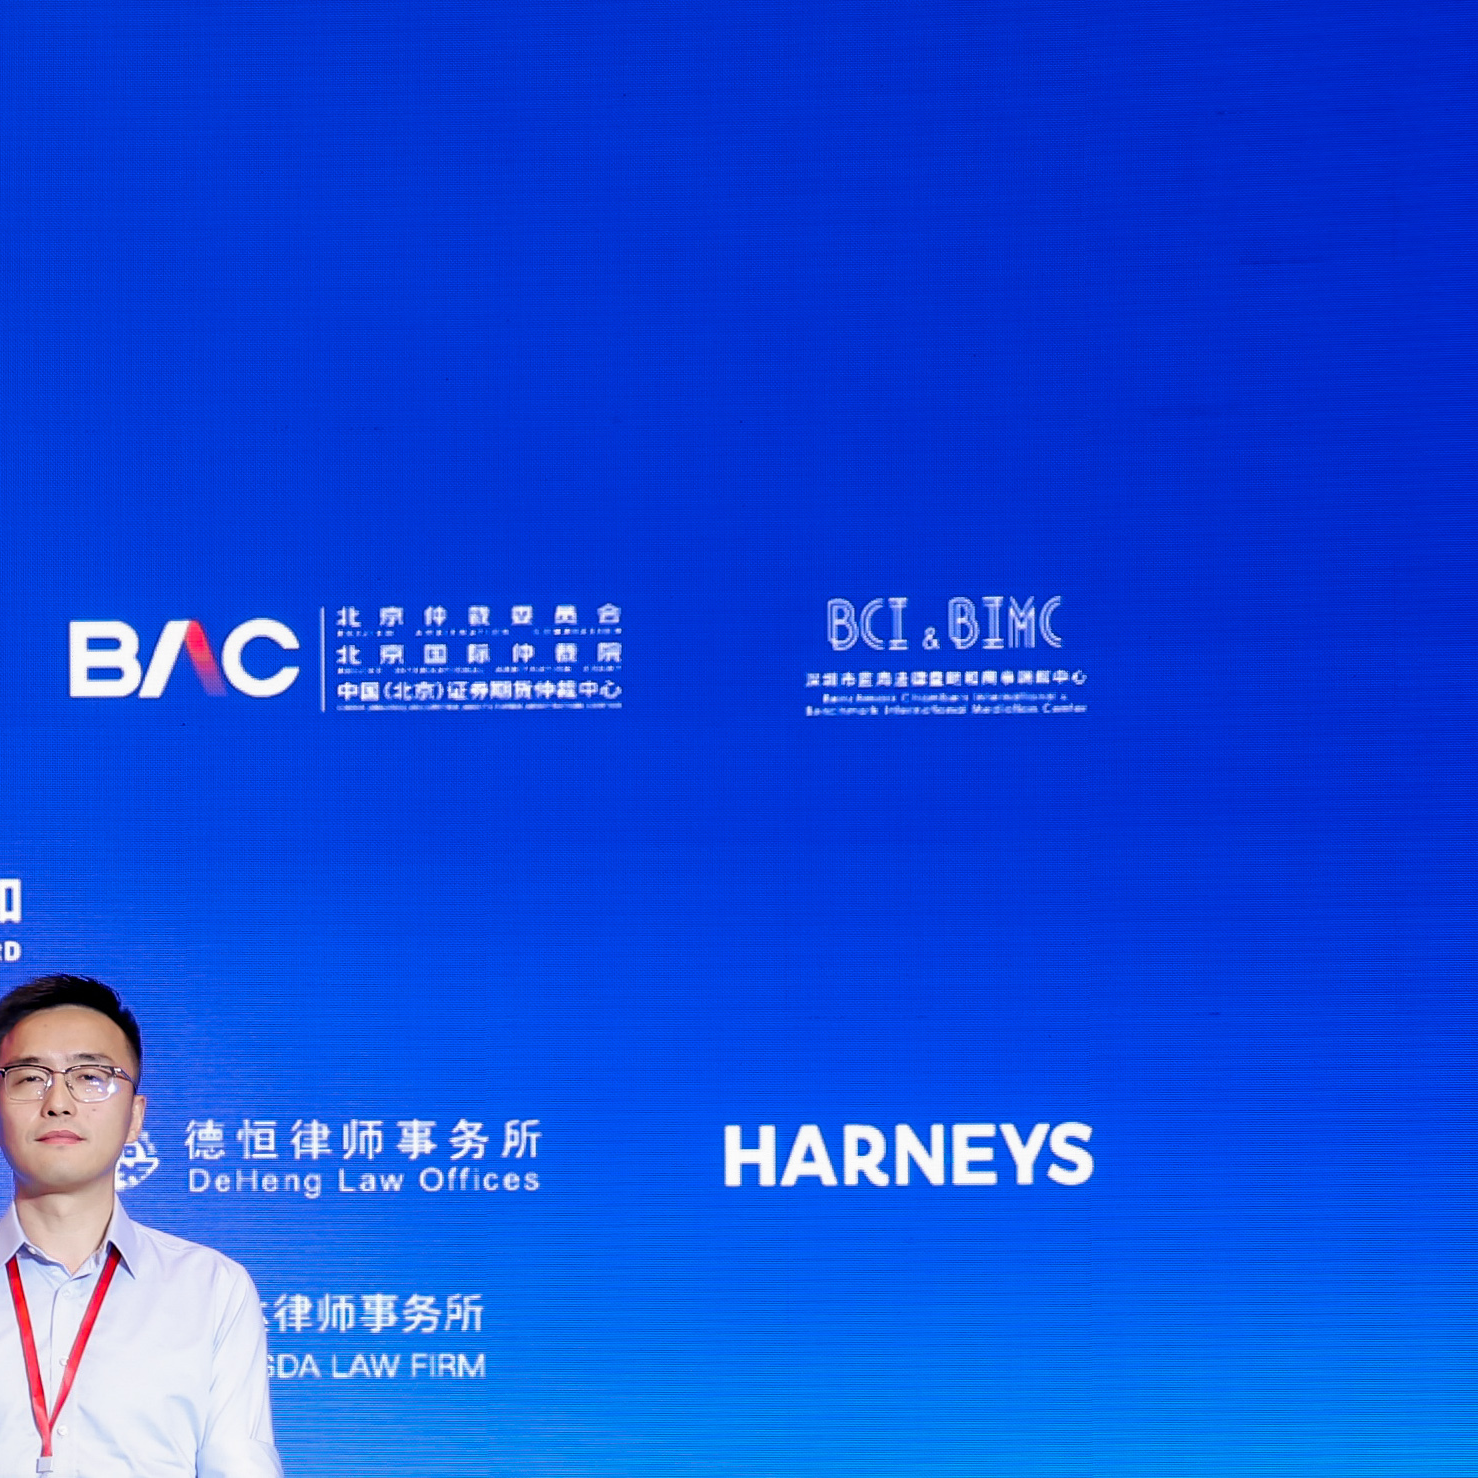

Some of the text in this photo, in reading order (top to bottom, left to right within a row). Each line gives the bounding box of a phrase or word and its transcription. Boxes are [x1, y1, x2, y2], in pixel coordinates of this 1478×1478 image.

[827, 596, 908, 651] BCI
[948, 595, 1062, 650] BIMC
[69, 617, 300, 699] BAC
[183, 1118, 542, 1161] 德恒律师事务所
[724, 1121, 1095, 1187] HARNEYS
[188, 1166, 541, 1200] DeHeng Law Offices
[331, 1353, 402, 1380] LAW
[411, 1353, 485, 1380] FIRM
